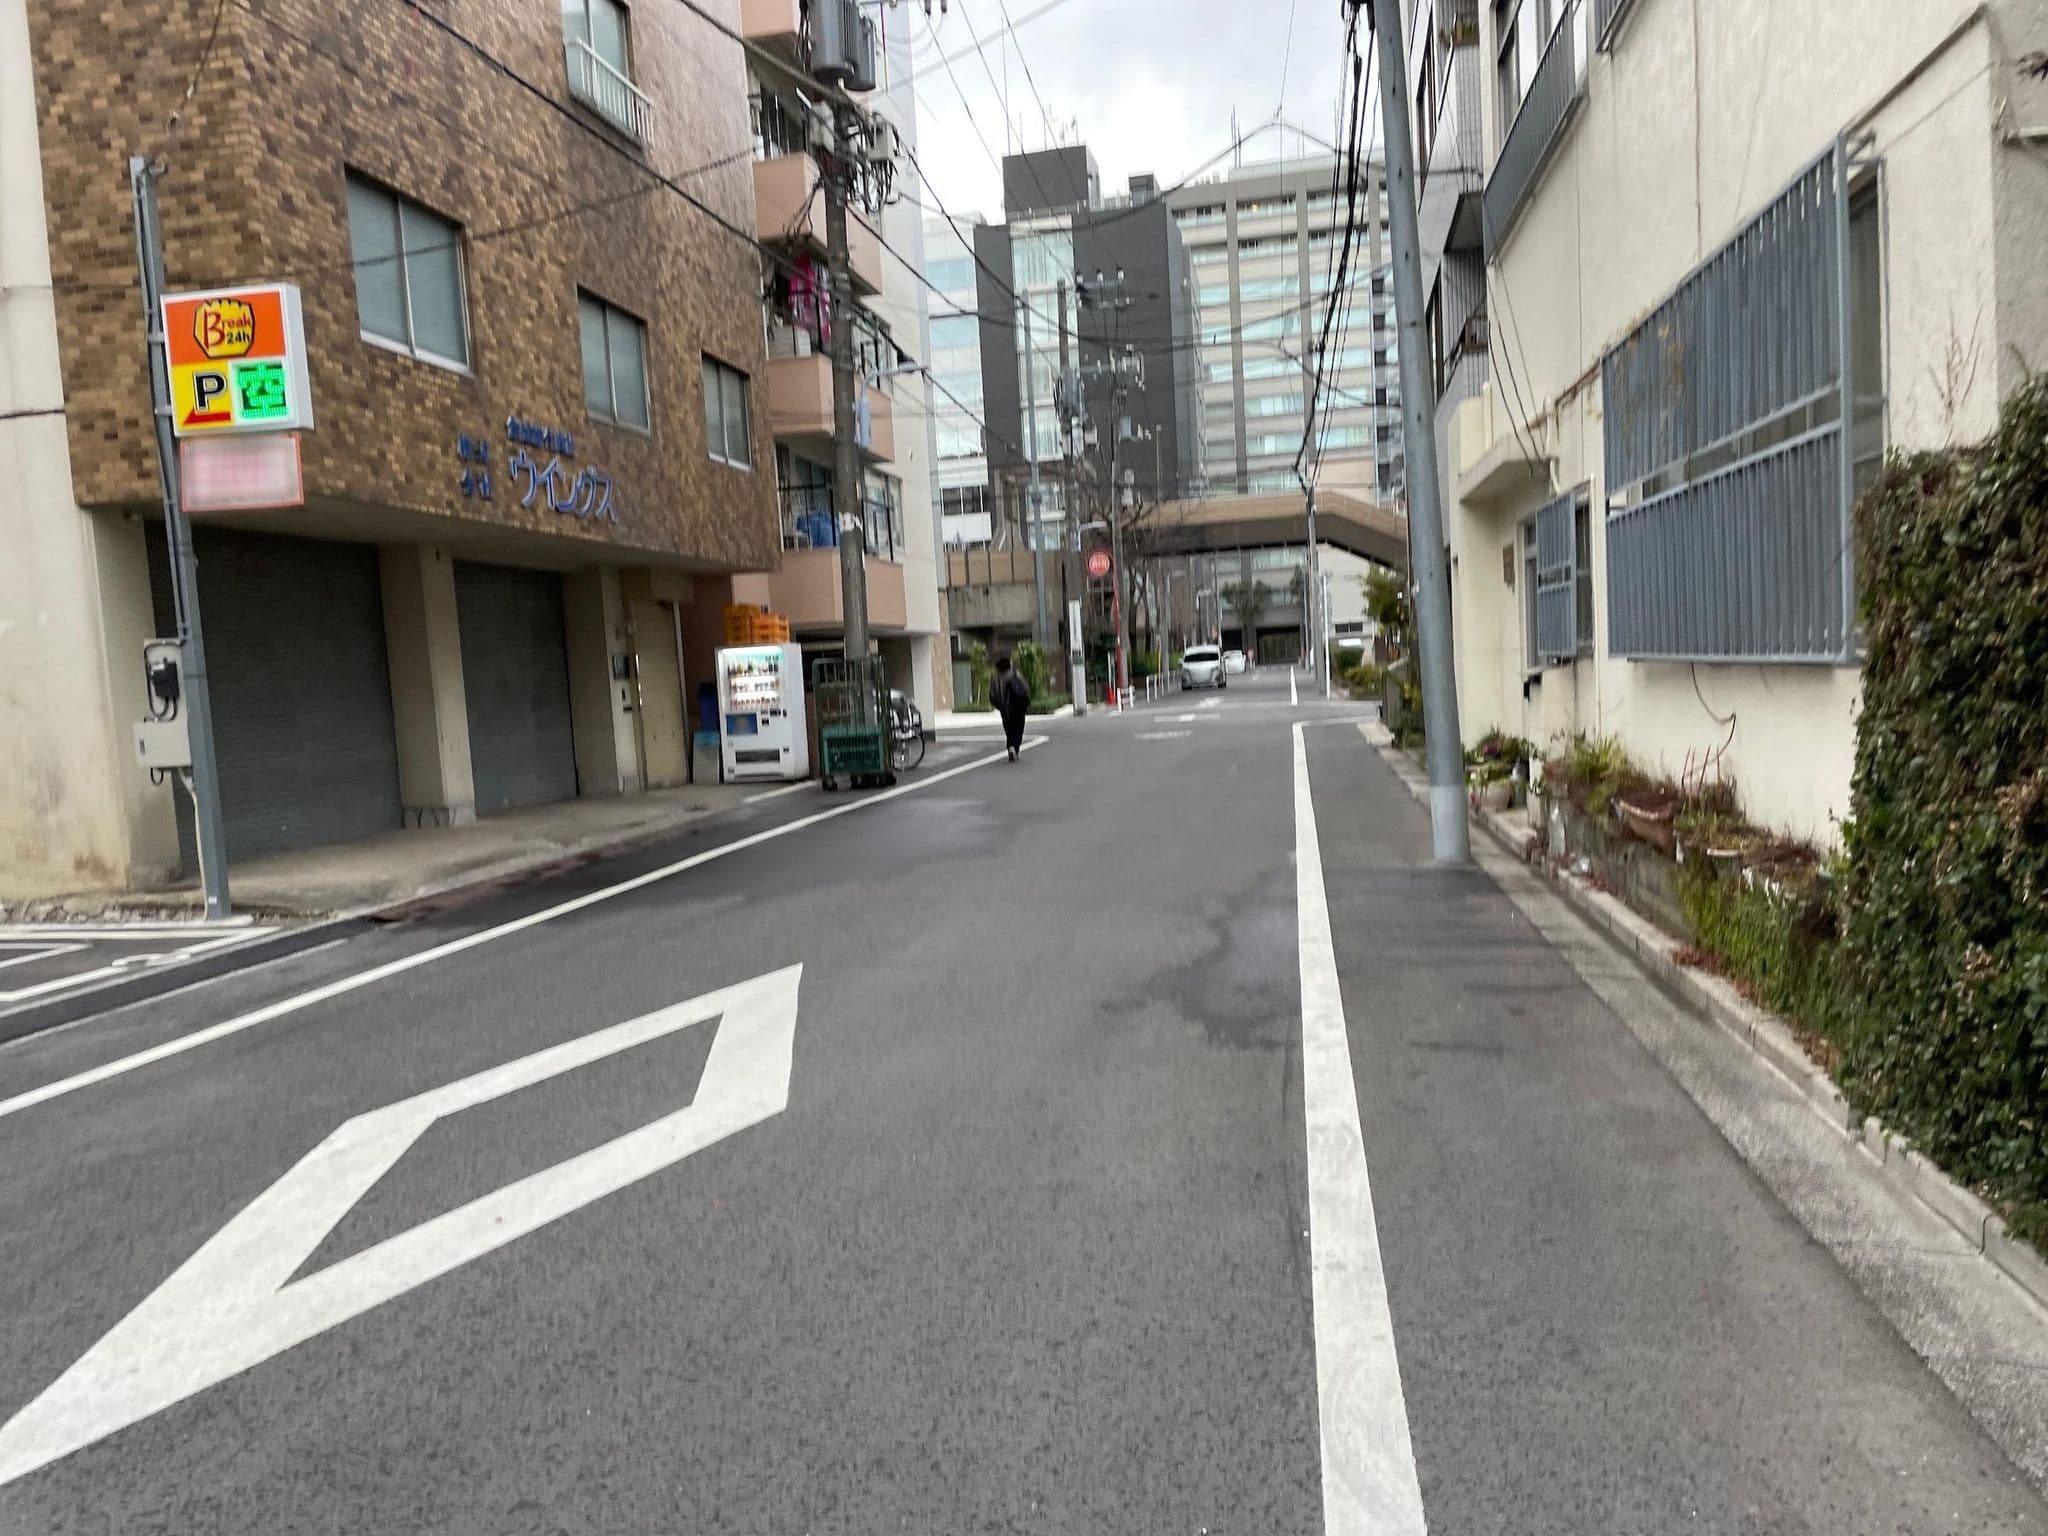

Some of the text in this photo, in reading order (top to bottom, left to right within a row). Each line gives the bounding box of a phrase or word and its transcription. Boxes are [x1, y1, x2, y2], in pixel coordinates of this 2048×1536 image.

[204, 310, 251, 349] Break
[226, 330, 251, 345] 24h
[194, 371, 227, 411] P
